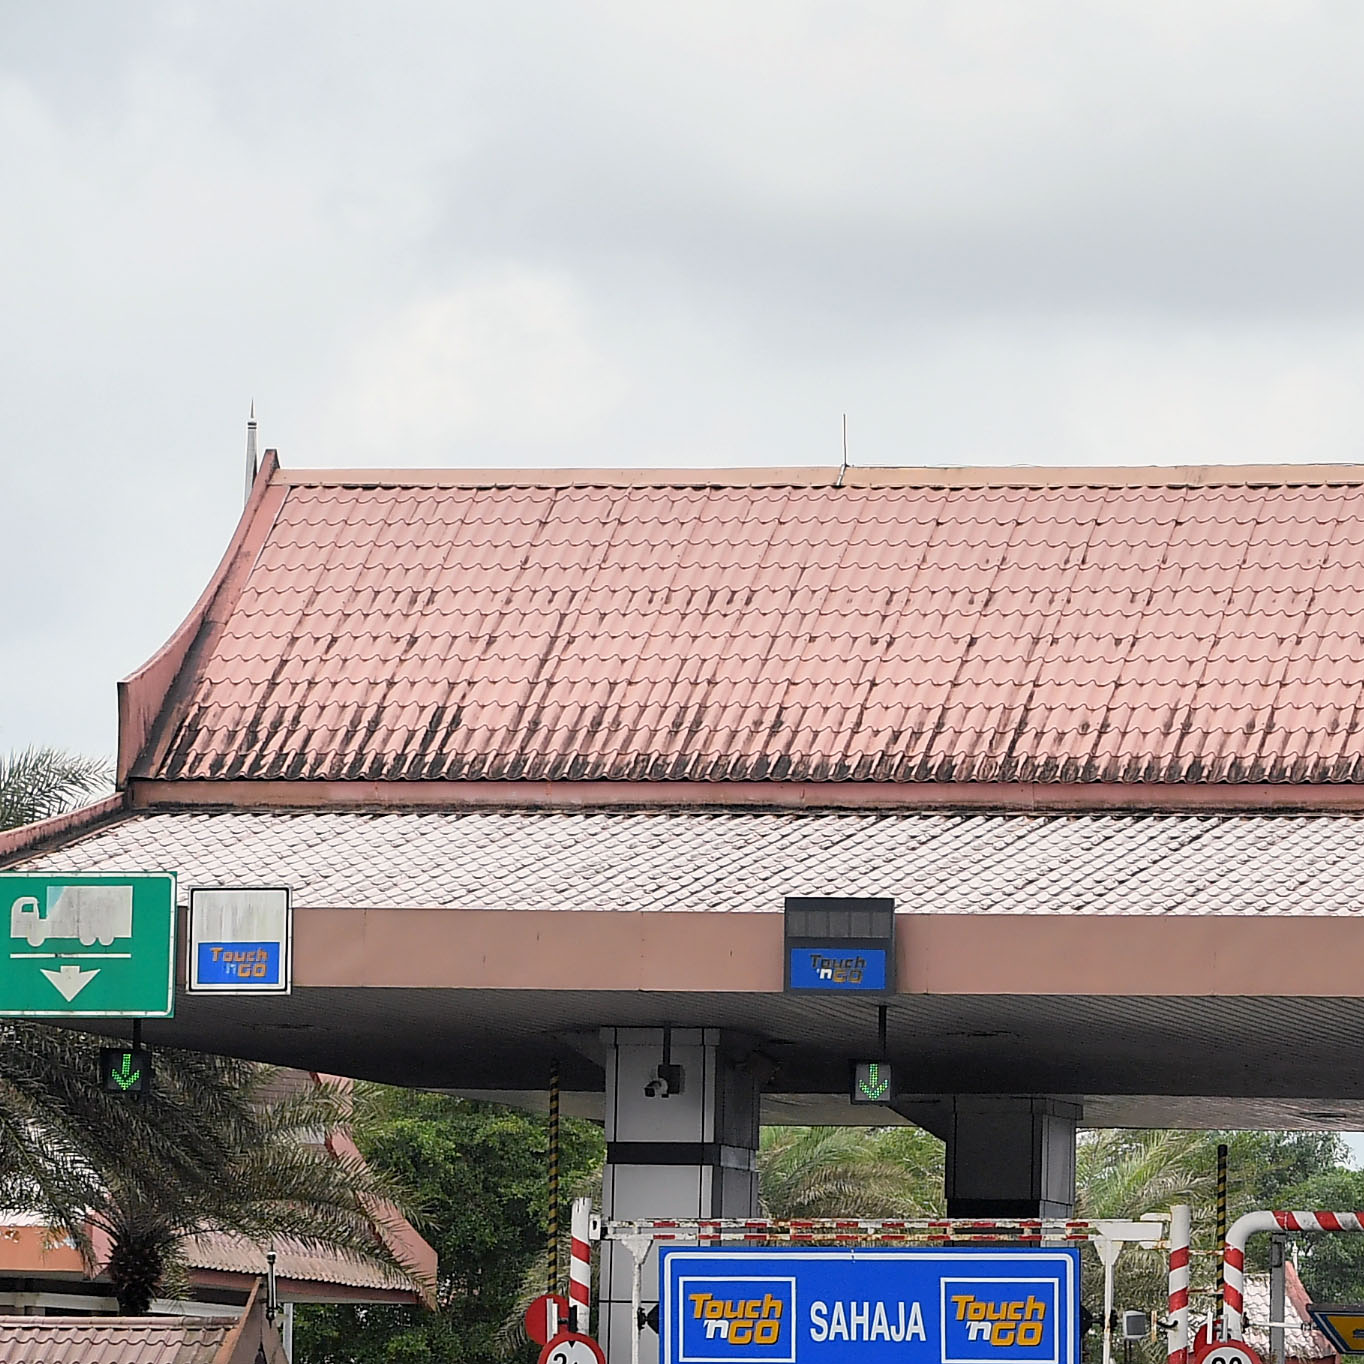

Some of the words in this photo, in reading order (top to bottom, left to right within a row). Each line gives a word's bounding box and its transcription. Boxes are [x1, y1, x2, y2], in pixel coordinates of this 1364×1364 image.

[210, 947, 268, 963] Touch
[810, 954, 867, 969] Touch
[689, 1293, 784, 1319] Touch
[951, 1295, 1047, 1321] Touch
[810, 1301, 927, 1342] SAHAJA
